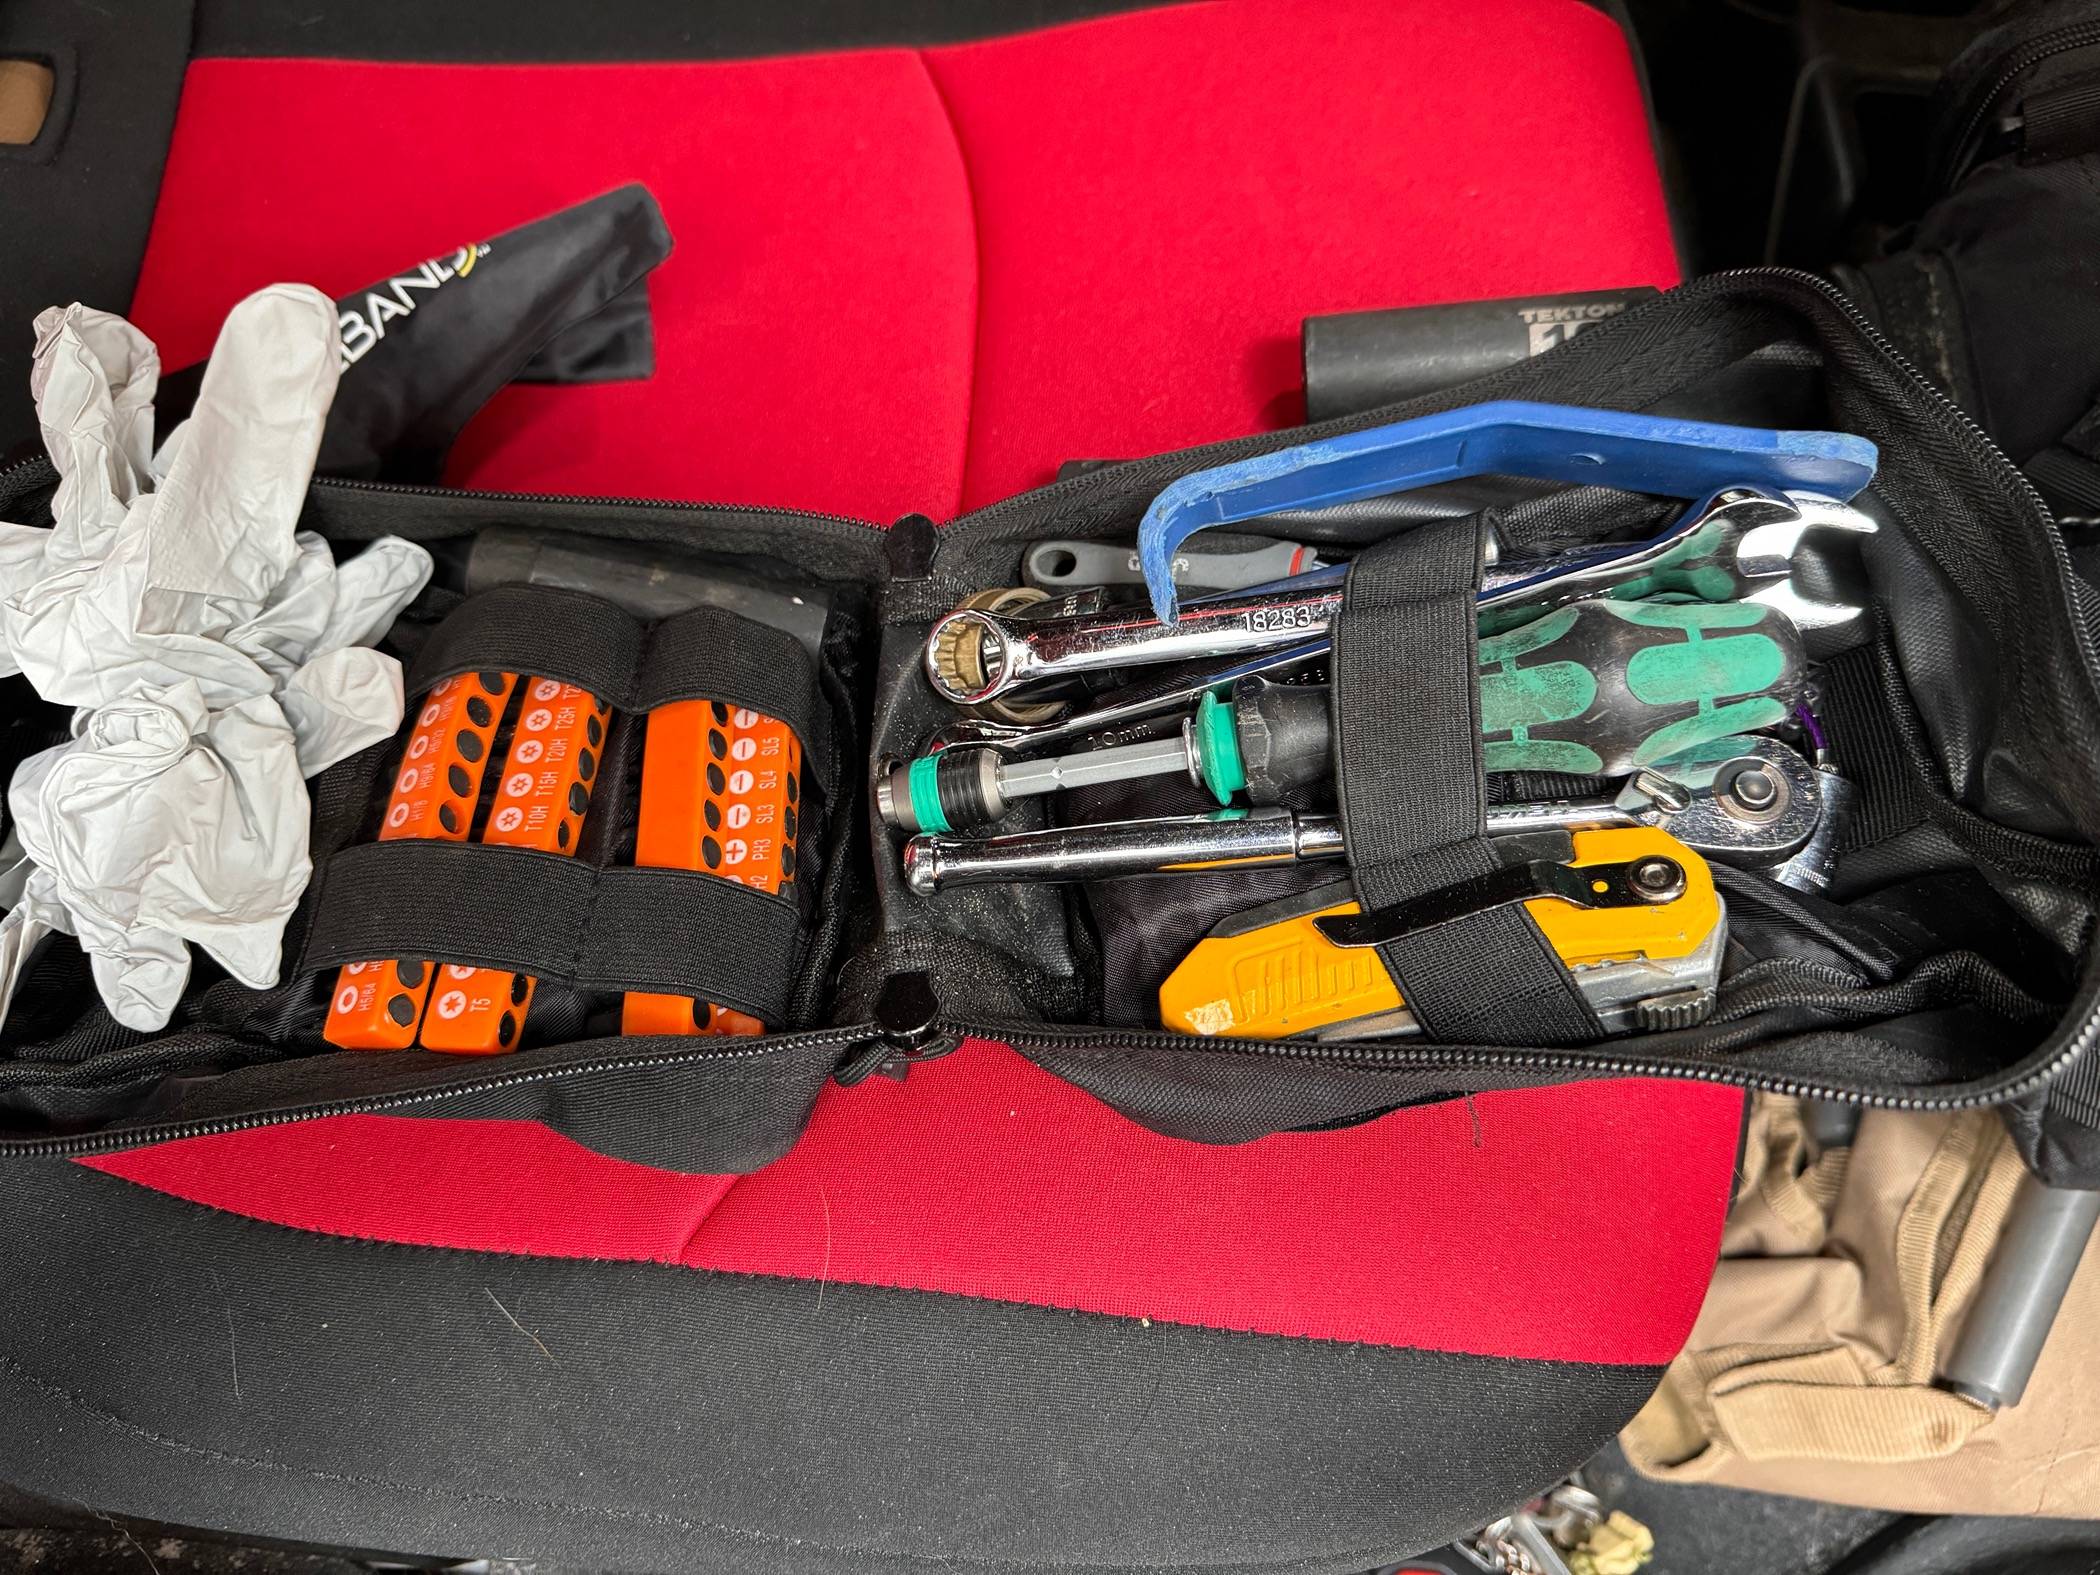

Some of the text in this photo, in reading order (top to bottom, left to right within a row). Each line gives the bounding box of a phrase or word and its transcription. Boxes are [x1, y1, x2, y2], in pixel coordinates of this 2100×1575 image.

[340, 243, 477, 374] BAND
[1241, 605, 1311, 632] 18283
[554, 706, 577, 731] T25H
[762, 736, 780, 756] SL5
[1087, 724, 1152, 751] 10mm
[544, 738, 568, 763] T20H
[535, 771, 560, 797] T15H
[759, 770, 777, 789] SL4
[410, 799, 429, 822] H1/8
[524, 805, 549, 832] T10H
[756, 804, 775, 824] SL3
[752, 838, 772, 861] PH3
[750, 874, 769, 889] H2
[357, 983, 377, 1012] H5/64
[469, 998, 491, 1013] T5
